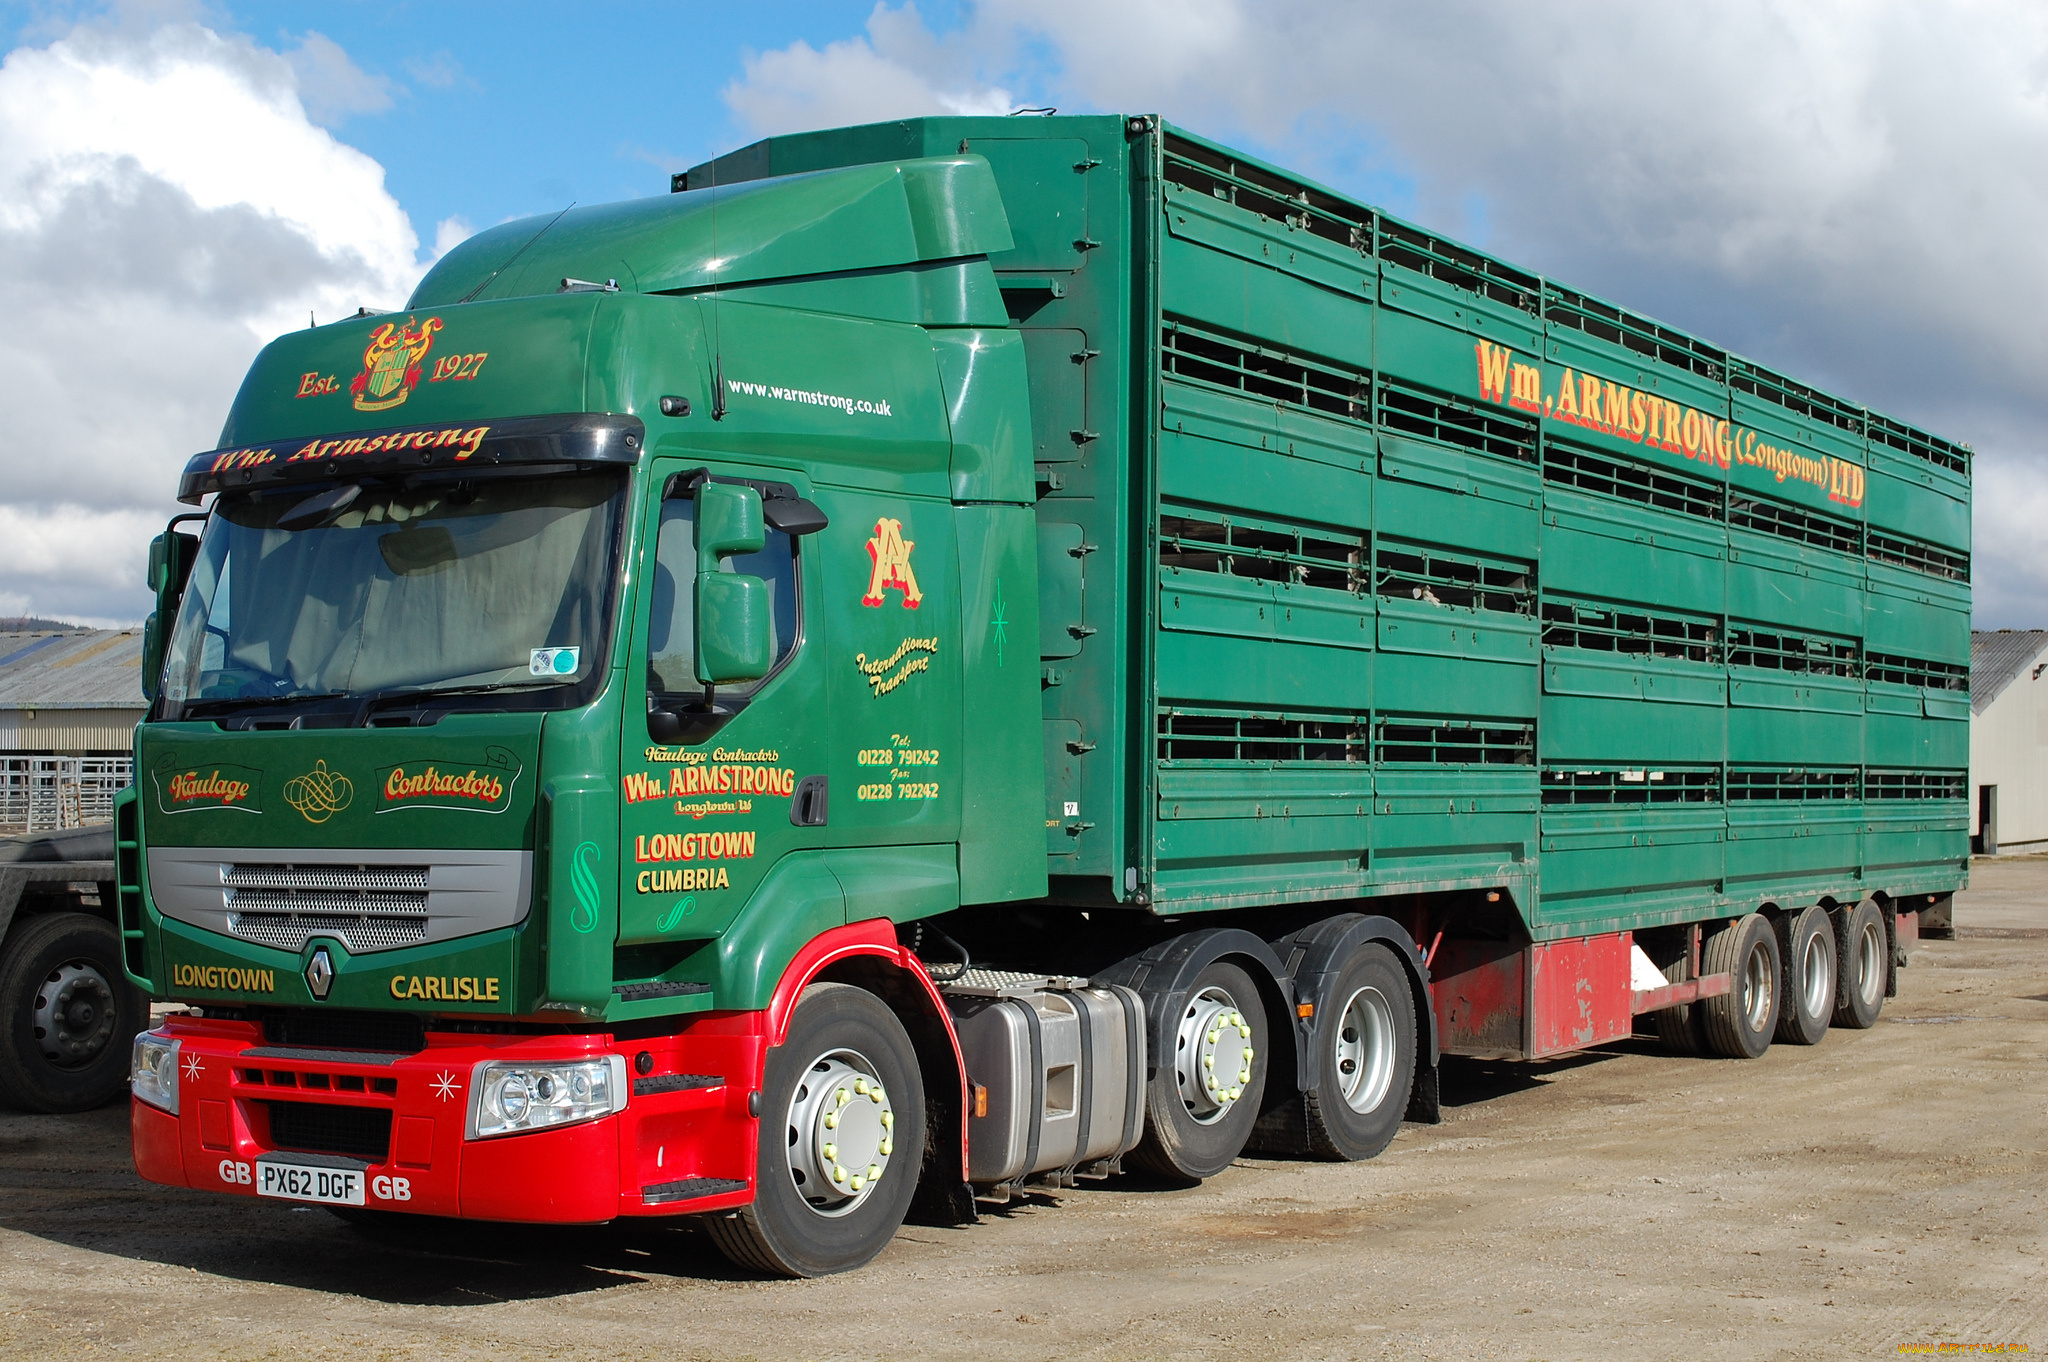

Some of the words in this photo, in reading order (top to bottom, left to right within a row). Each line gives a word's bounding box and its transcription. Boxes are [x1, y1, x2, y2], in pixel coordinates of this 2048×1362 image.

[430, 353, 488, 382] 1927
[296, 371, 340, 398] Est.
[728, 380, 892, 416] www.warmstrong.co.uk
[1475, 338, 1552, 417] Wm.
[1553, 367, 1733, 469] ARMSTRONG
[1734, 427, 1829, 490] (Longtown)
[1829, 456, 1865, 508] LTD
[211, 448, 276, 475] Wm.
[287, 426, 490, 461] Armstrong
[856, 637, 938, 674] International
[869, 656, 929, 699] Transport
[645, 747, 708, 766] Haulage
[712, 747, 779, 763] Contractors
[857, 749, 893, 766] 01228
[898, 749, 940, 766] 791242
[169, 771, 249, 805] Haulage
[385, 767, 503, 803] Contractors
[669, 765, 795, 797] ARMSTRONG
[857, 783, 893, 801] 01228
[898, 783, 940, 801] 792242
[636, 831, 756, 862] LONGTOWN
[636, 867, 730, 894] CUMBRIA
[173, 964, 274, 992] LONGTOWN
[390, 975, 499, 1001] CARLISLE
[219, 1159, 252, 1185] GB
[264, 1166, 312, 1196] PX62
[318, 1172, 356, 1199] DGF
[372, 1175, 412, 1200] GB
